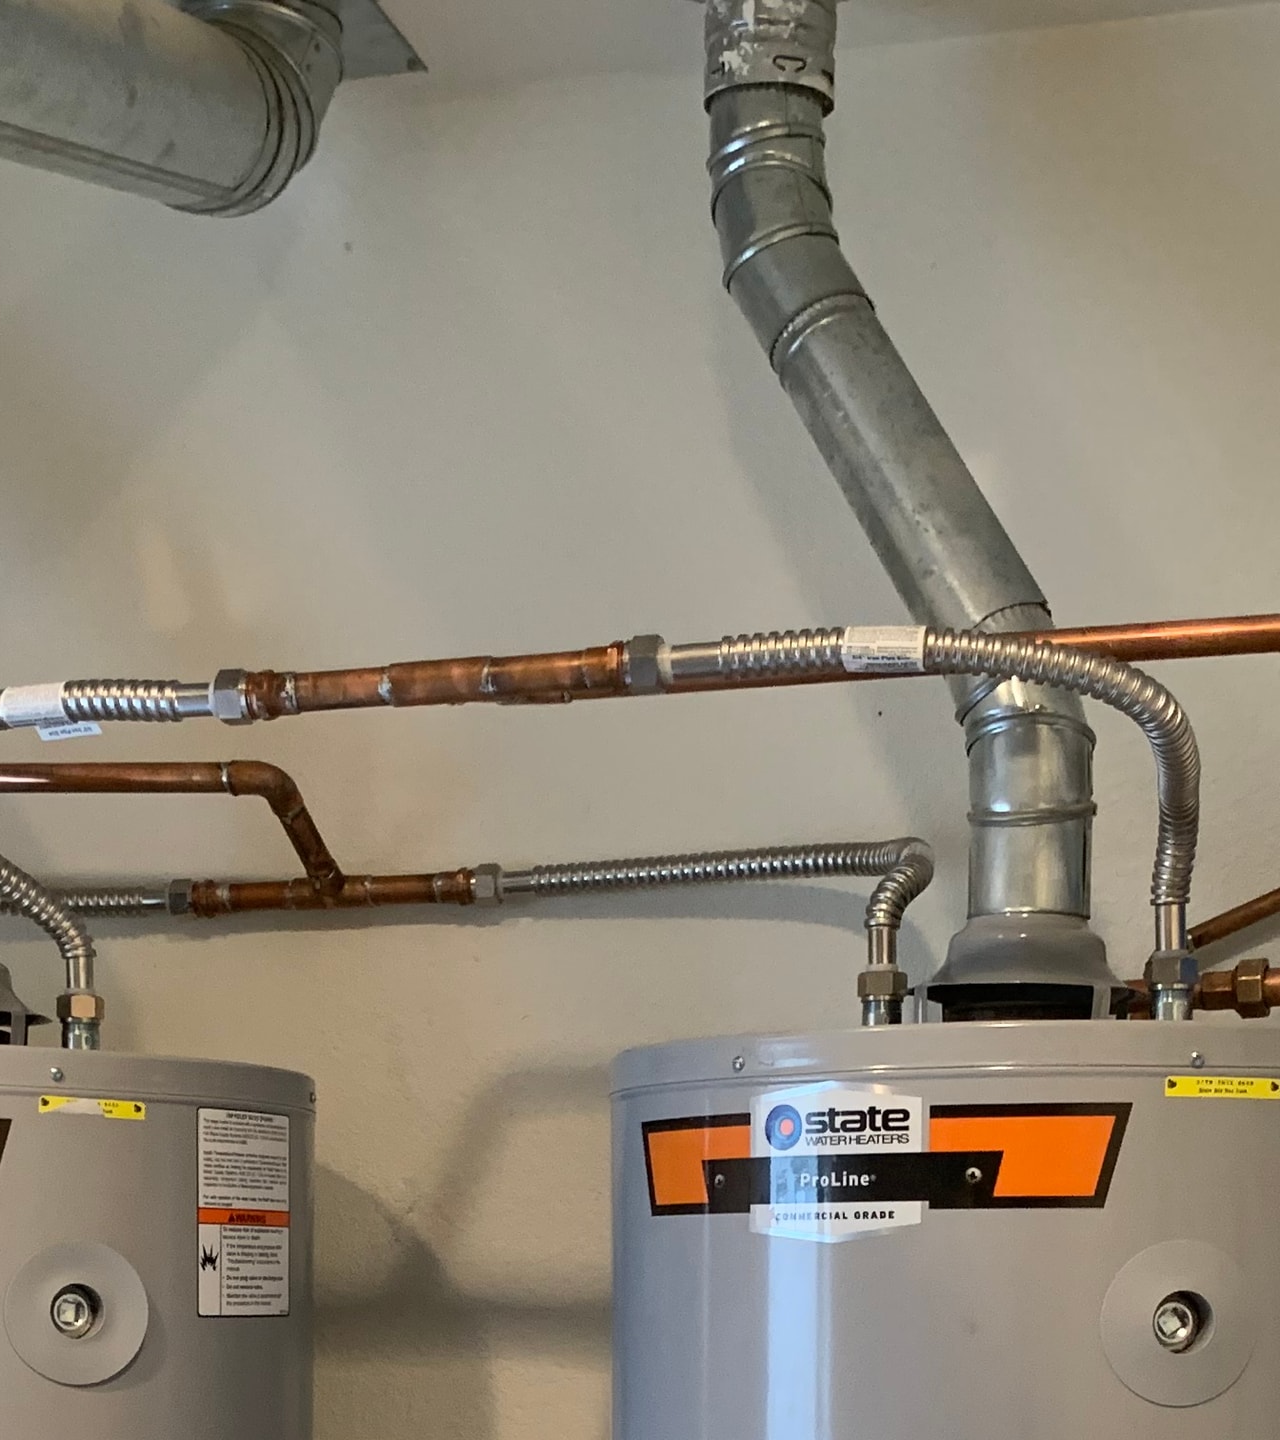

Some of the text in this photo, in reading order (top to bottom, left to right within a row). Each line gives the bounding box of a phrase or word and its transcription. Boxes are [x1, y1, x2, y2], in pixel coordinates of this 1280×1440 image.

[805, 1106, 910, 1134] state
[805, 1134, 909, 1146] WATER HEATERS
[775, 1211, 895, 1221] COMMERCIAL GRADE
